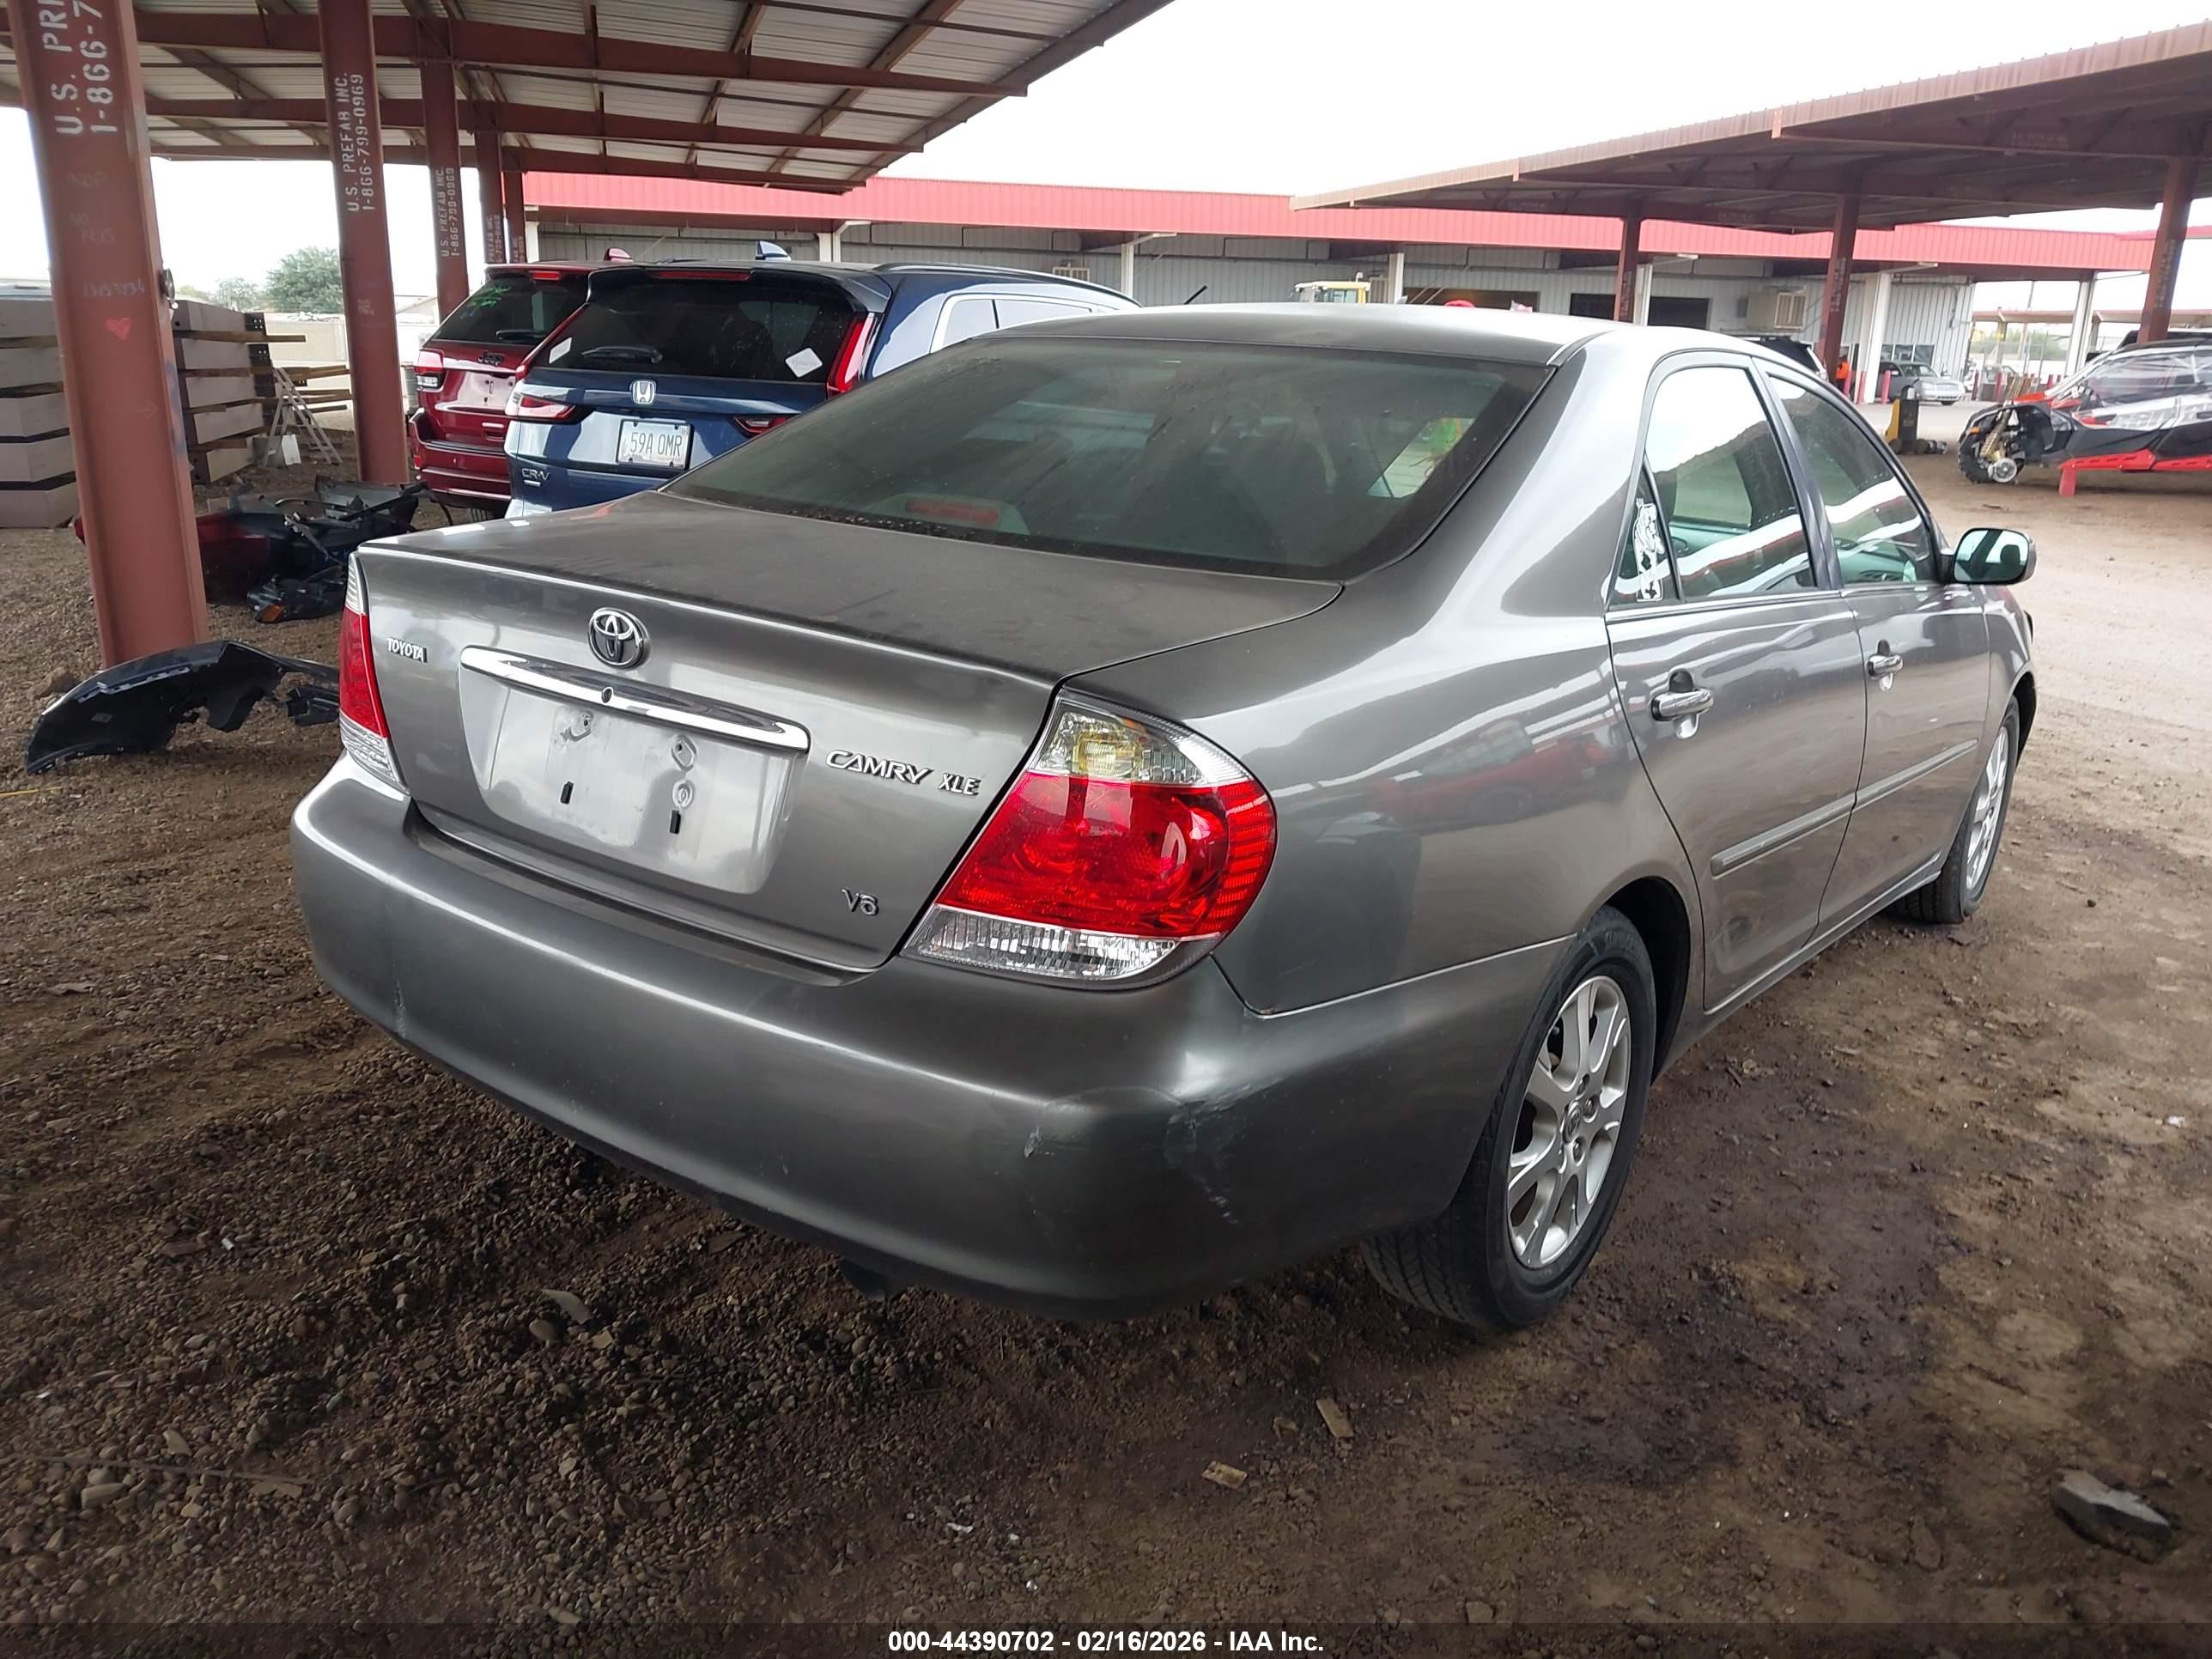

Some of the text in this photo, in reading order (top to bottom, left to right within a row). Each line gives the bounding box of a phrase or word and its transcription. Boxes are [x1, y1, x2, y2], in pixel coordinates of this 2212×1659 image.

[51, 74, 83, 134] U.S.
[334, 72, 360, 212] U.S. PREFAB INC.
[349, 74, 375, 210] 1-866-799-0969
[630, 432, 653, 454] 59A
[386, 637, 428, 663] TOYOTA
[826, 749, 981, 795] CAMRY XLE
[842, 888, 879, 916] V6
